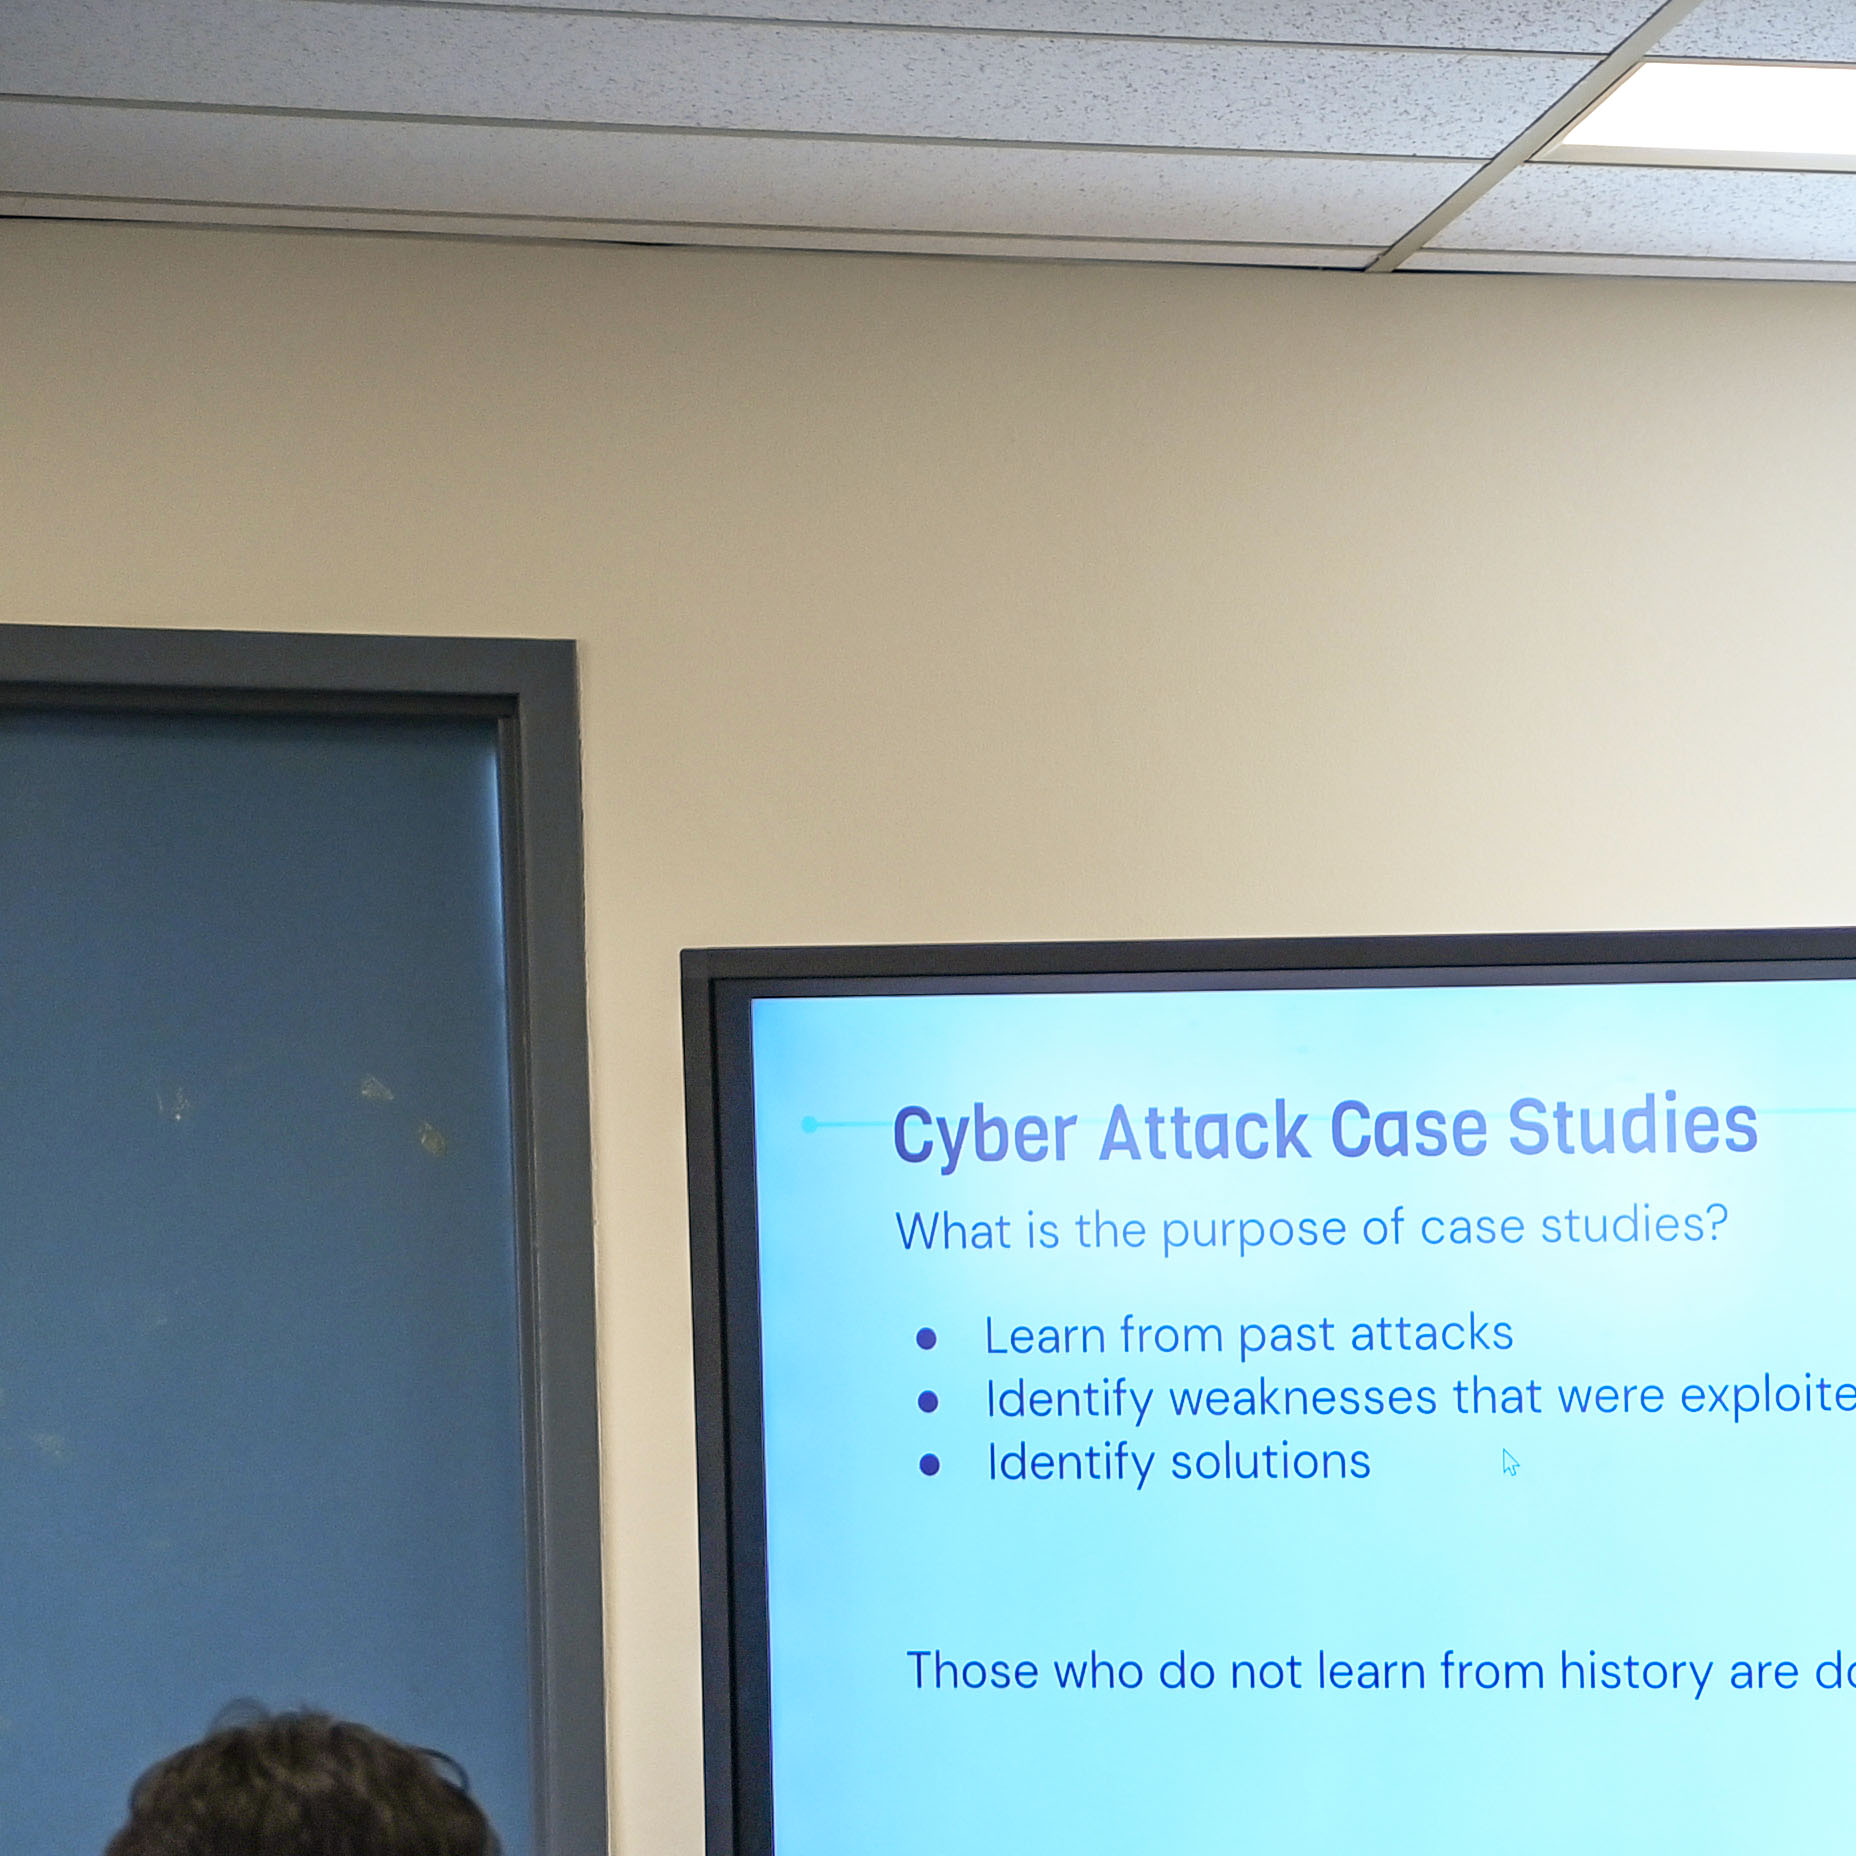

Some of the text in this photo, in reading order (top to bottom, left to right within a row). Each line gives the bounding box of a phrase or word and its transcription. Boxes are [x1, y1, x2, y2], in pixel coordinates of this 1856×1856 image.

[894, 1089, 1758, 1176] Cyber Attack Case Studies
[896, 1202, 1728, 1258] What is the purpose of case studies?
[986, 1310, 1514, 1364] Learn from past attacks
[988, 1376, 1154, 1428] Identify
[1169, 1375, 1437, 1416] weaknesses
[1452, 1374, 1543, 1414] that
[1557, 1384, 1665, 1414] were
[989, 1439, 1371, 1491] Identify solutions
[906, 1649, 1039, 1690] Those
[1053, 1649, 1144, 1689] who
[1159, 1649, 1215, 1690] do
[1231, 1655, 1303, 1690] not
[1319, 1649, 1425, 1690] learn
[1440, 1649, 1544, 1690] from
[1561, 1649, 1714, 1701] history
[1730, 1660, 1799, 1690] are
